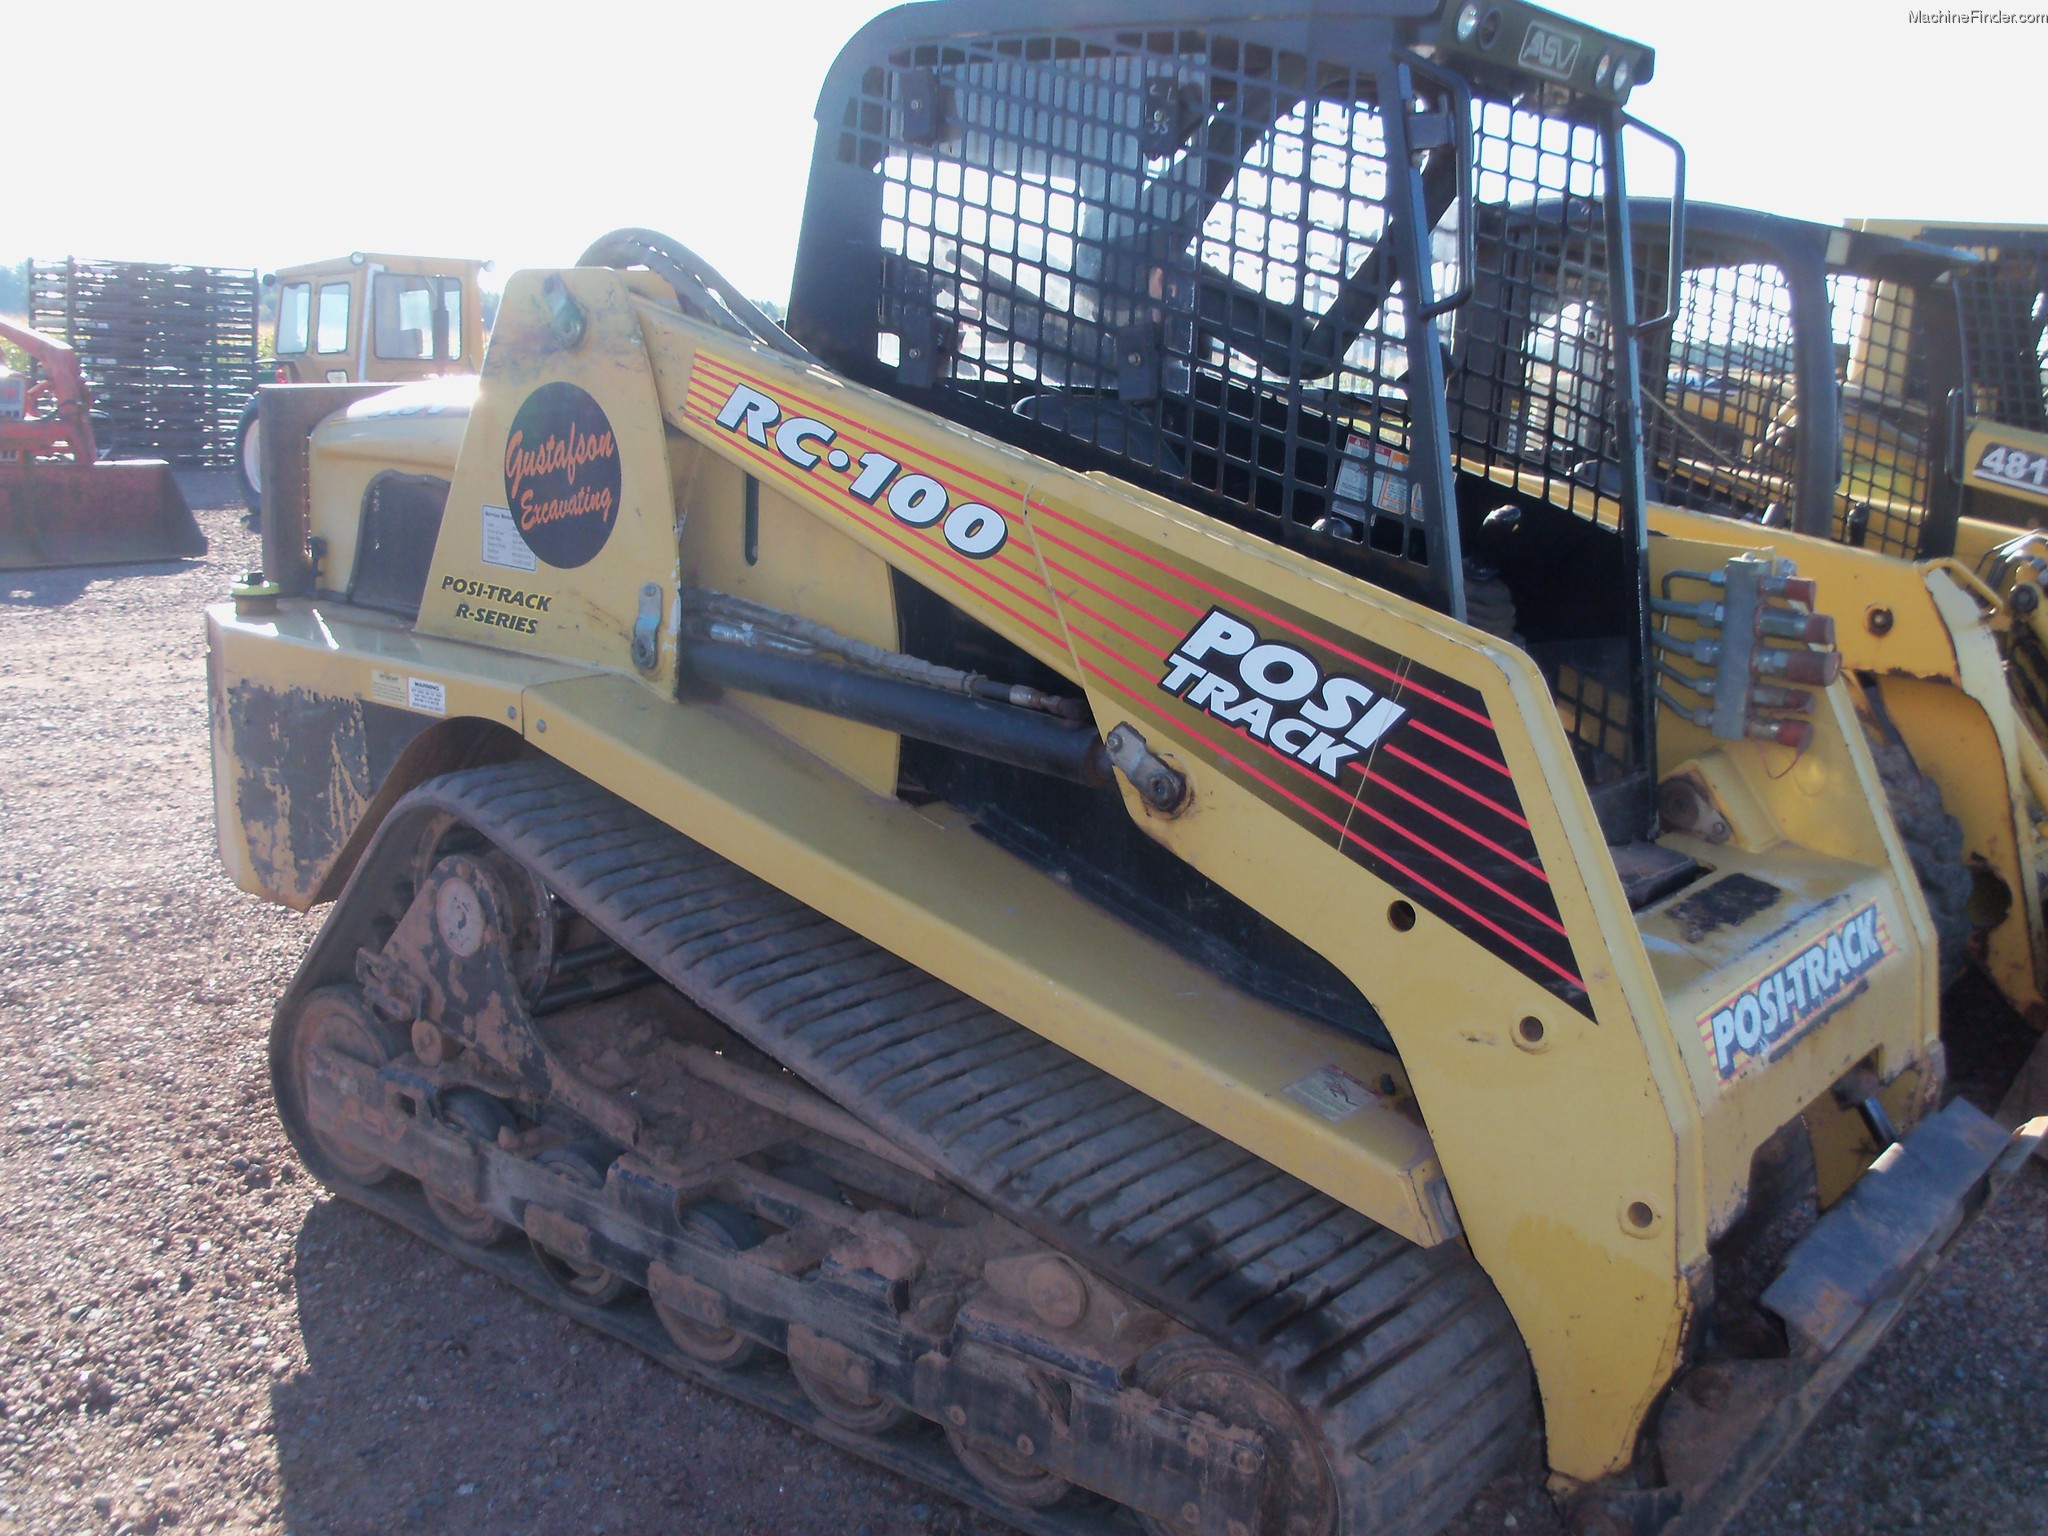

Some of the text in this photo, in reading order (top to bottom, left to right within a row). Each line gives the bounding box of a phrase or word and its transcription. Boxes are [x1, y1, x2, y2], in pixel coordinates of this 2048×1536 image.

[1521, 30, 1578, 71] ASV
[505, 421, 614, 499] Gustafson
[1981, 446, 2048, 485] 481
[520, 485, 613, 531] Excavating
[441, 575, 552, 612] POSI-TRACK
[456, 603, 538, 634] R-SERIES
[1180, 610, 1406, 749] POSI
[1161, 653, 1359, 778] TRACK
[1711, 905, 1884, 1079] POSI-TRACK
